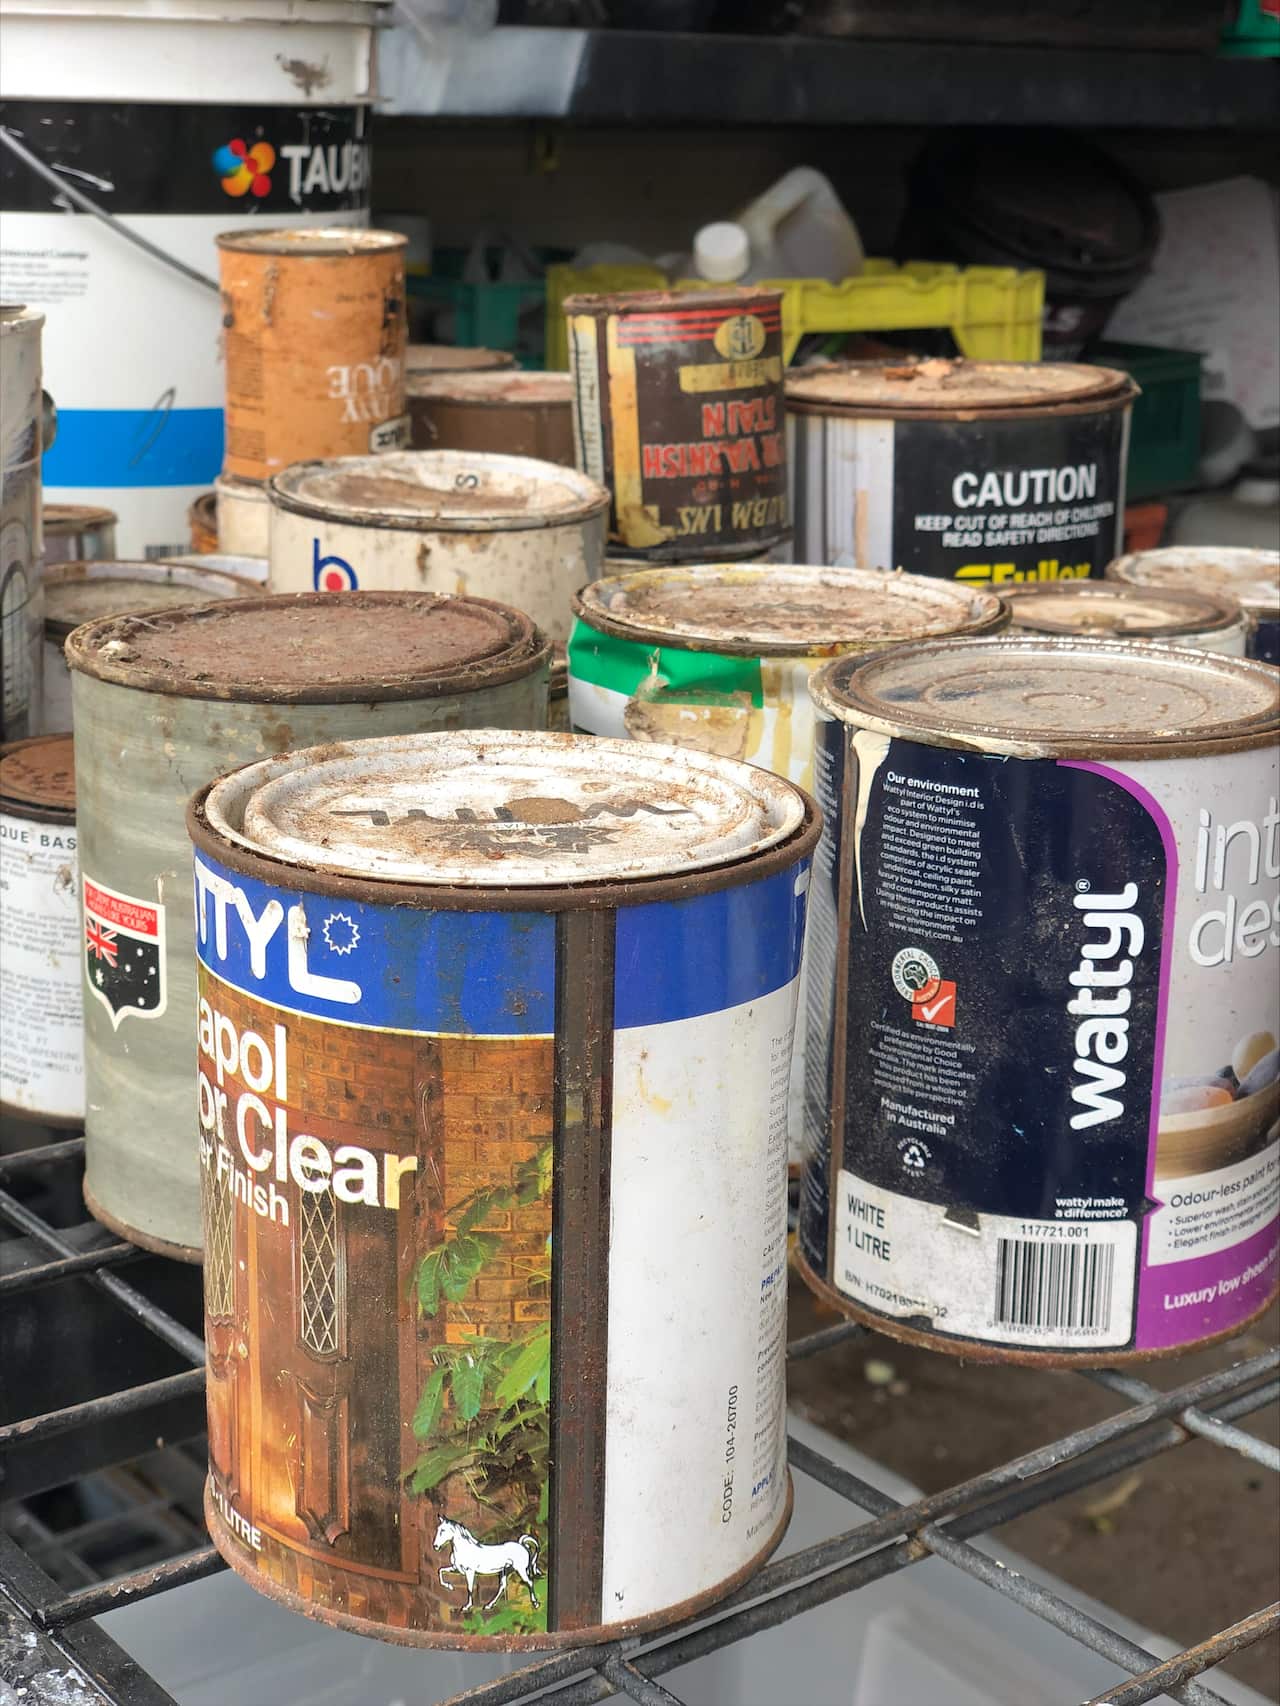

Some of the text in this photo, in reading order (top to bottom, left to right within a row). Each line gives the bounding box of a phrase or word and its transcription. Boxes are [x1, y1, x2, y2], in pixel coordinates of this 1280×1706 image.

[951, 463, 1097, 509] CAUTION
[914, 515, 952, 531] KEEP
[954, 514, 986, 531] OUT
[988, 513, 1008, 529] OF
[1009, 510, 1053, 528] REACH
[1054, 508, 1071, 524] OF
[942, 521, 1099, 548] READ SAFETY DIRECTIONS
[882, 783, 906, 797] Wattyl
[906, 788, 937, 802] Interior
[936, 795, 965, 807] Design
[977, 802, 985, 810] is
[887, 771, 979, 798] Our environment
[329, 800, 695, 827] WTTYL
[887, 805, 976, 828] eco system to minimise
[900, 799, 960, 816] part of Wattyl's
[883, 814, 980, 838] odour and environmental
[40, 834, 77, 850] BAS
[881, 832, 981, 860] and exceed green building
[909, 829, 946, 843] Designed
[947, 836, 957, 845] to
[957, 839, 980, 849] meet
[880, 851, 980, 878] comprises of acrylic sealer
[921, 852, 934, 860] the
[947, 857, 977, 868] system
[878, 869, 899, 882] luxury
[900, 875, 913, 884] low
[940, 884, 960, 895] silky
[960, 888, 982, 898] satin
[923, 872, 950, 884] ceiling
[875, 887, 983, 917] Using these products assists
[882, 881, 896, 890] and
[895, 885, 951, 904] contemporary
[887, 901, 920, 916] reducing
[920, 909, 933, 918] the
[934, 912, 963, 924] impact
[964, 918, 976, 926] on
[893, 912, 906, 921] our
[195, 856, 362, 1004] TTYL
[888, 921, 964, 943] www.wattyl.com.au
[197, 993, 288, 1102] apol
[870, 1020, 900, 1036] Certified
[901, 1031, 910, 1039] as
[910, 1034, 976, 1053] environmentally
[884, 1035, 957, 1058] preferable by Good
[879, 1060, 960, 1087] this product has been
[902, 1058, 915, 1068] The
[916, 1060, 937, 1073] mark
[937, 1066, 976, 1080] indicates
[933, 1057, 962, 1069] Choice
[873, 1078, 901, 1093] product
[907, 1077, 925, 1088] from
[931, 1085, 957, 1096] whole
[881, 1097, 955, 1125] Manufactured
[887, 1111, 947, 1135] in Australia
[236, 1093, 418, 1210] Clear
[216, 1143, 290, 1228] Finish
[1170, 1180, 1241, 1209] Odour-less
[1242, 1166, 1266, 1192] paint
[848, 1193, 885, 1229] WHITE
[1055, 1196, 1125, 1210] wattyl make
[1055, 1208, 1128, 1219] a difference?
[1175, 1209, 1213, 1225] Superior
[1021, 1224, 1089, 1238] 117721.001
[1174, 1222, 1203, 1237] Lower
[1174, 1231, 1208, 1248] Elegant
[1209, 1226, 1231, 1240] finish
[847, 1224, 891, 1261] 1 LITRE
[1164, 1286, 1217, 1310] Luxury
[1218, 1274, 1242, 1296] low
[722, 1384, 739, 1524] CODE: 104-20700
[224, 1500, 262, 1552] LITRE
